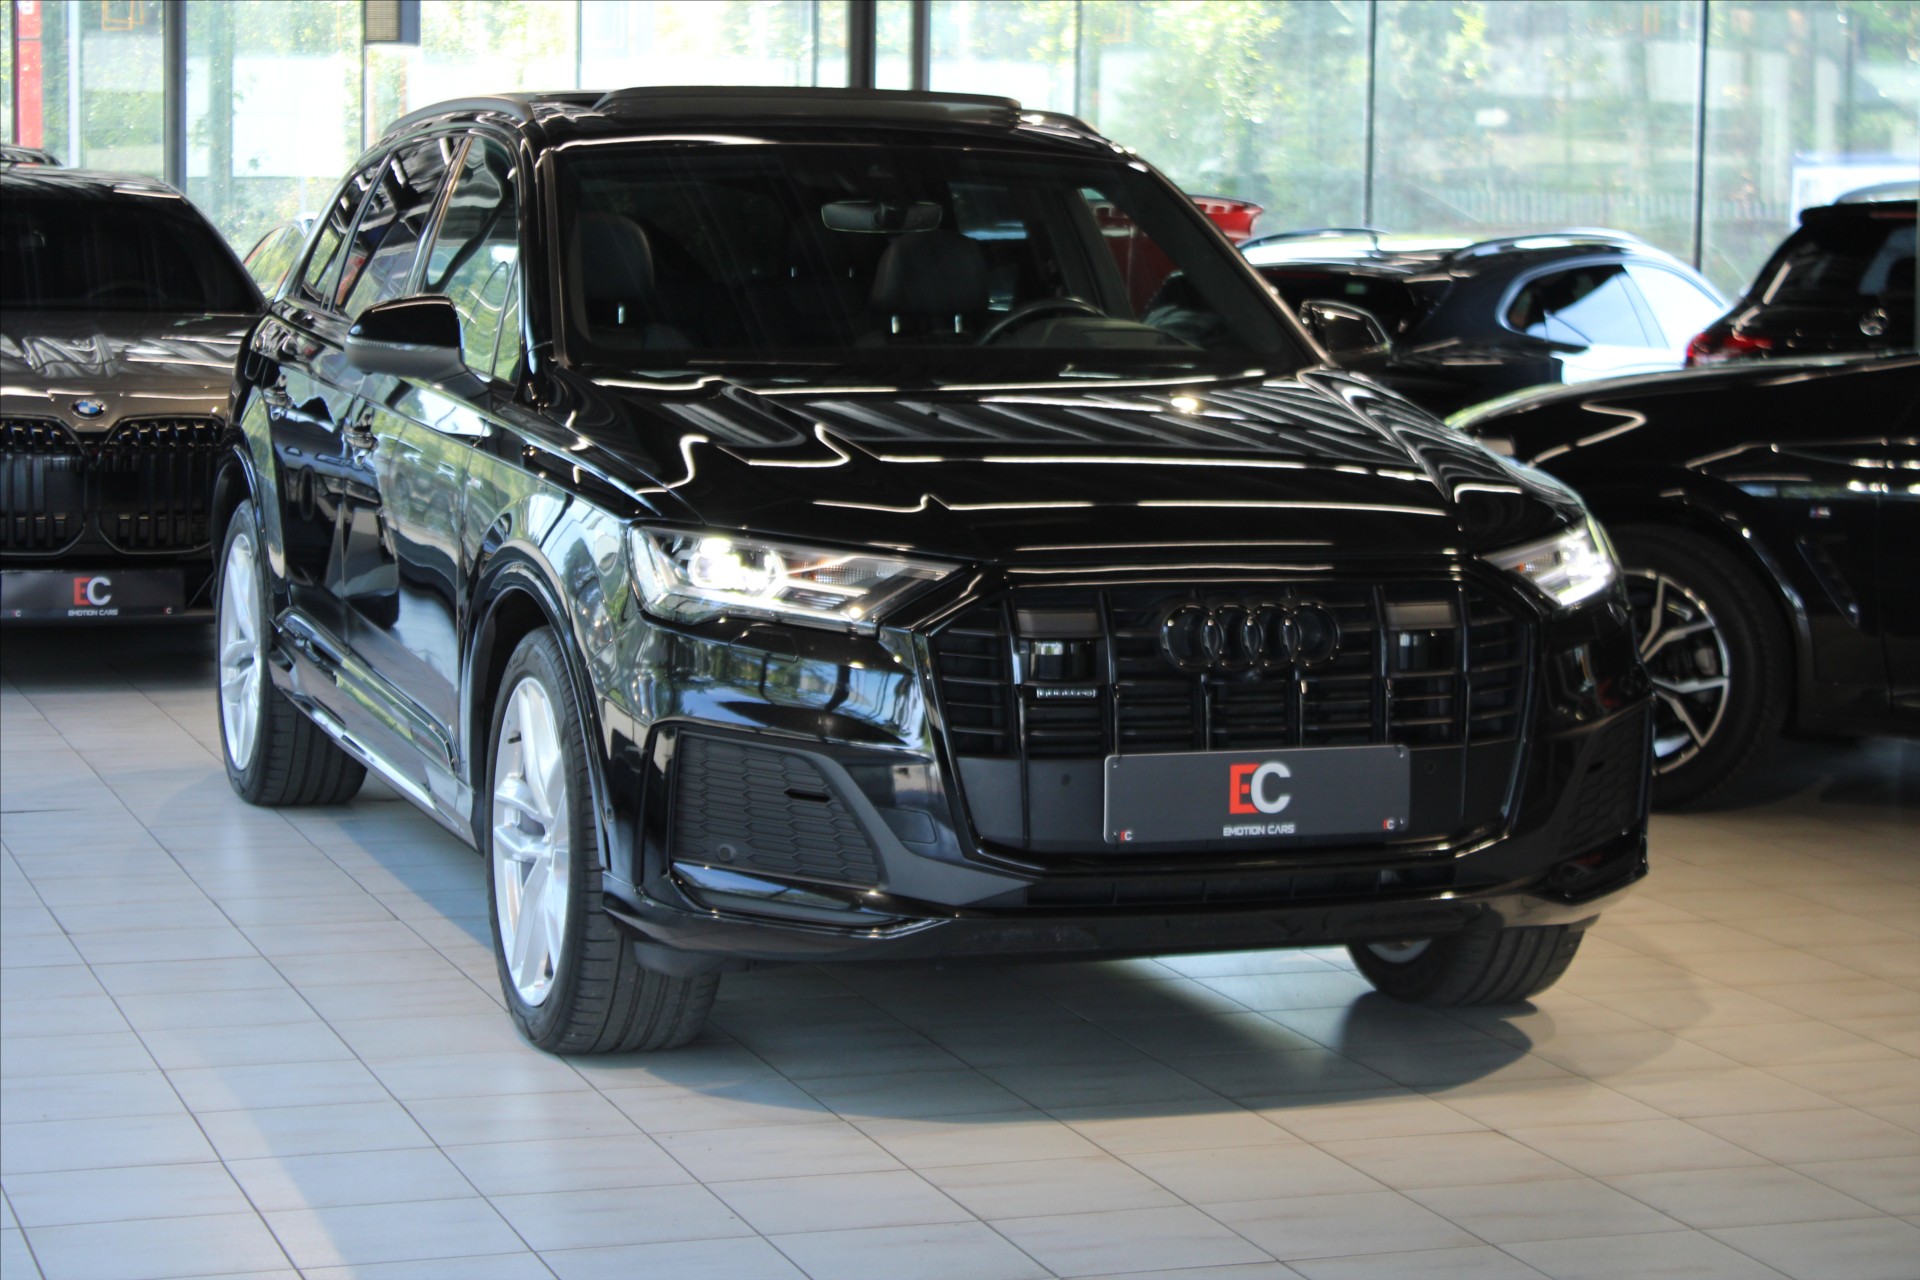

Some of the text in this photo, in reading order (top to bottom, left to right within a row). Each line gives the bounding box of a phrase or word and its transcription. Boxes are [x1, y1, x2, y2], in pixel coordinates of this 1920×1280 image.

[73, 576, 112, 606] EC
[68, 609, 118, 617] EMOTION CARS
[1229, 761, 1291, 814] EC
[1223, 823, 1296, 837] EMOTION CARS
